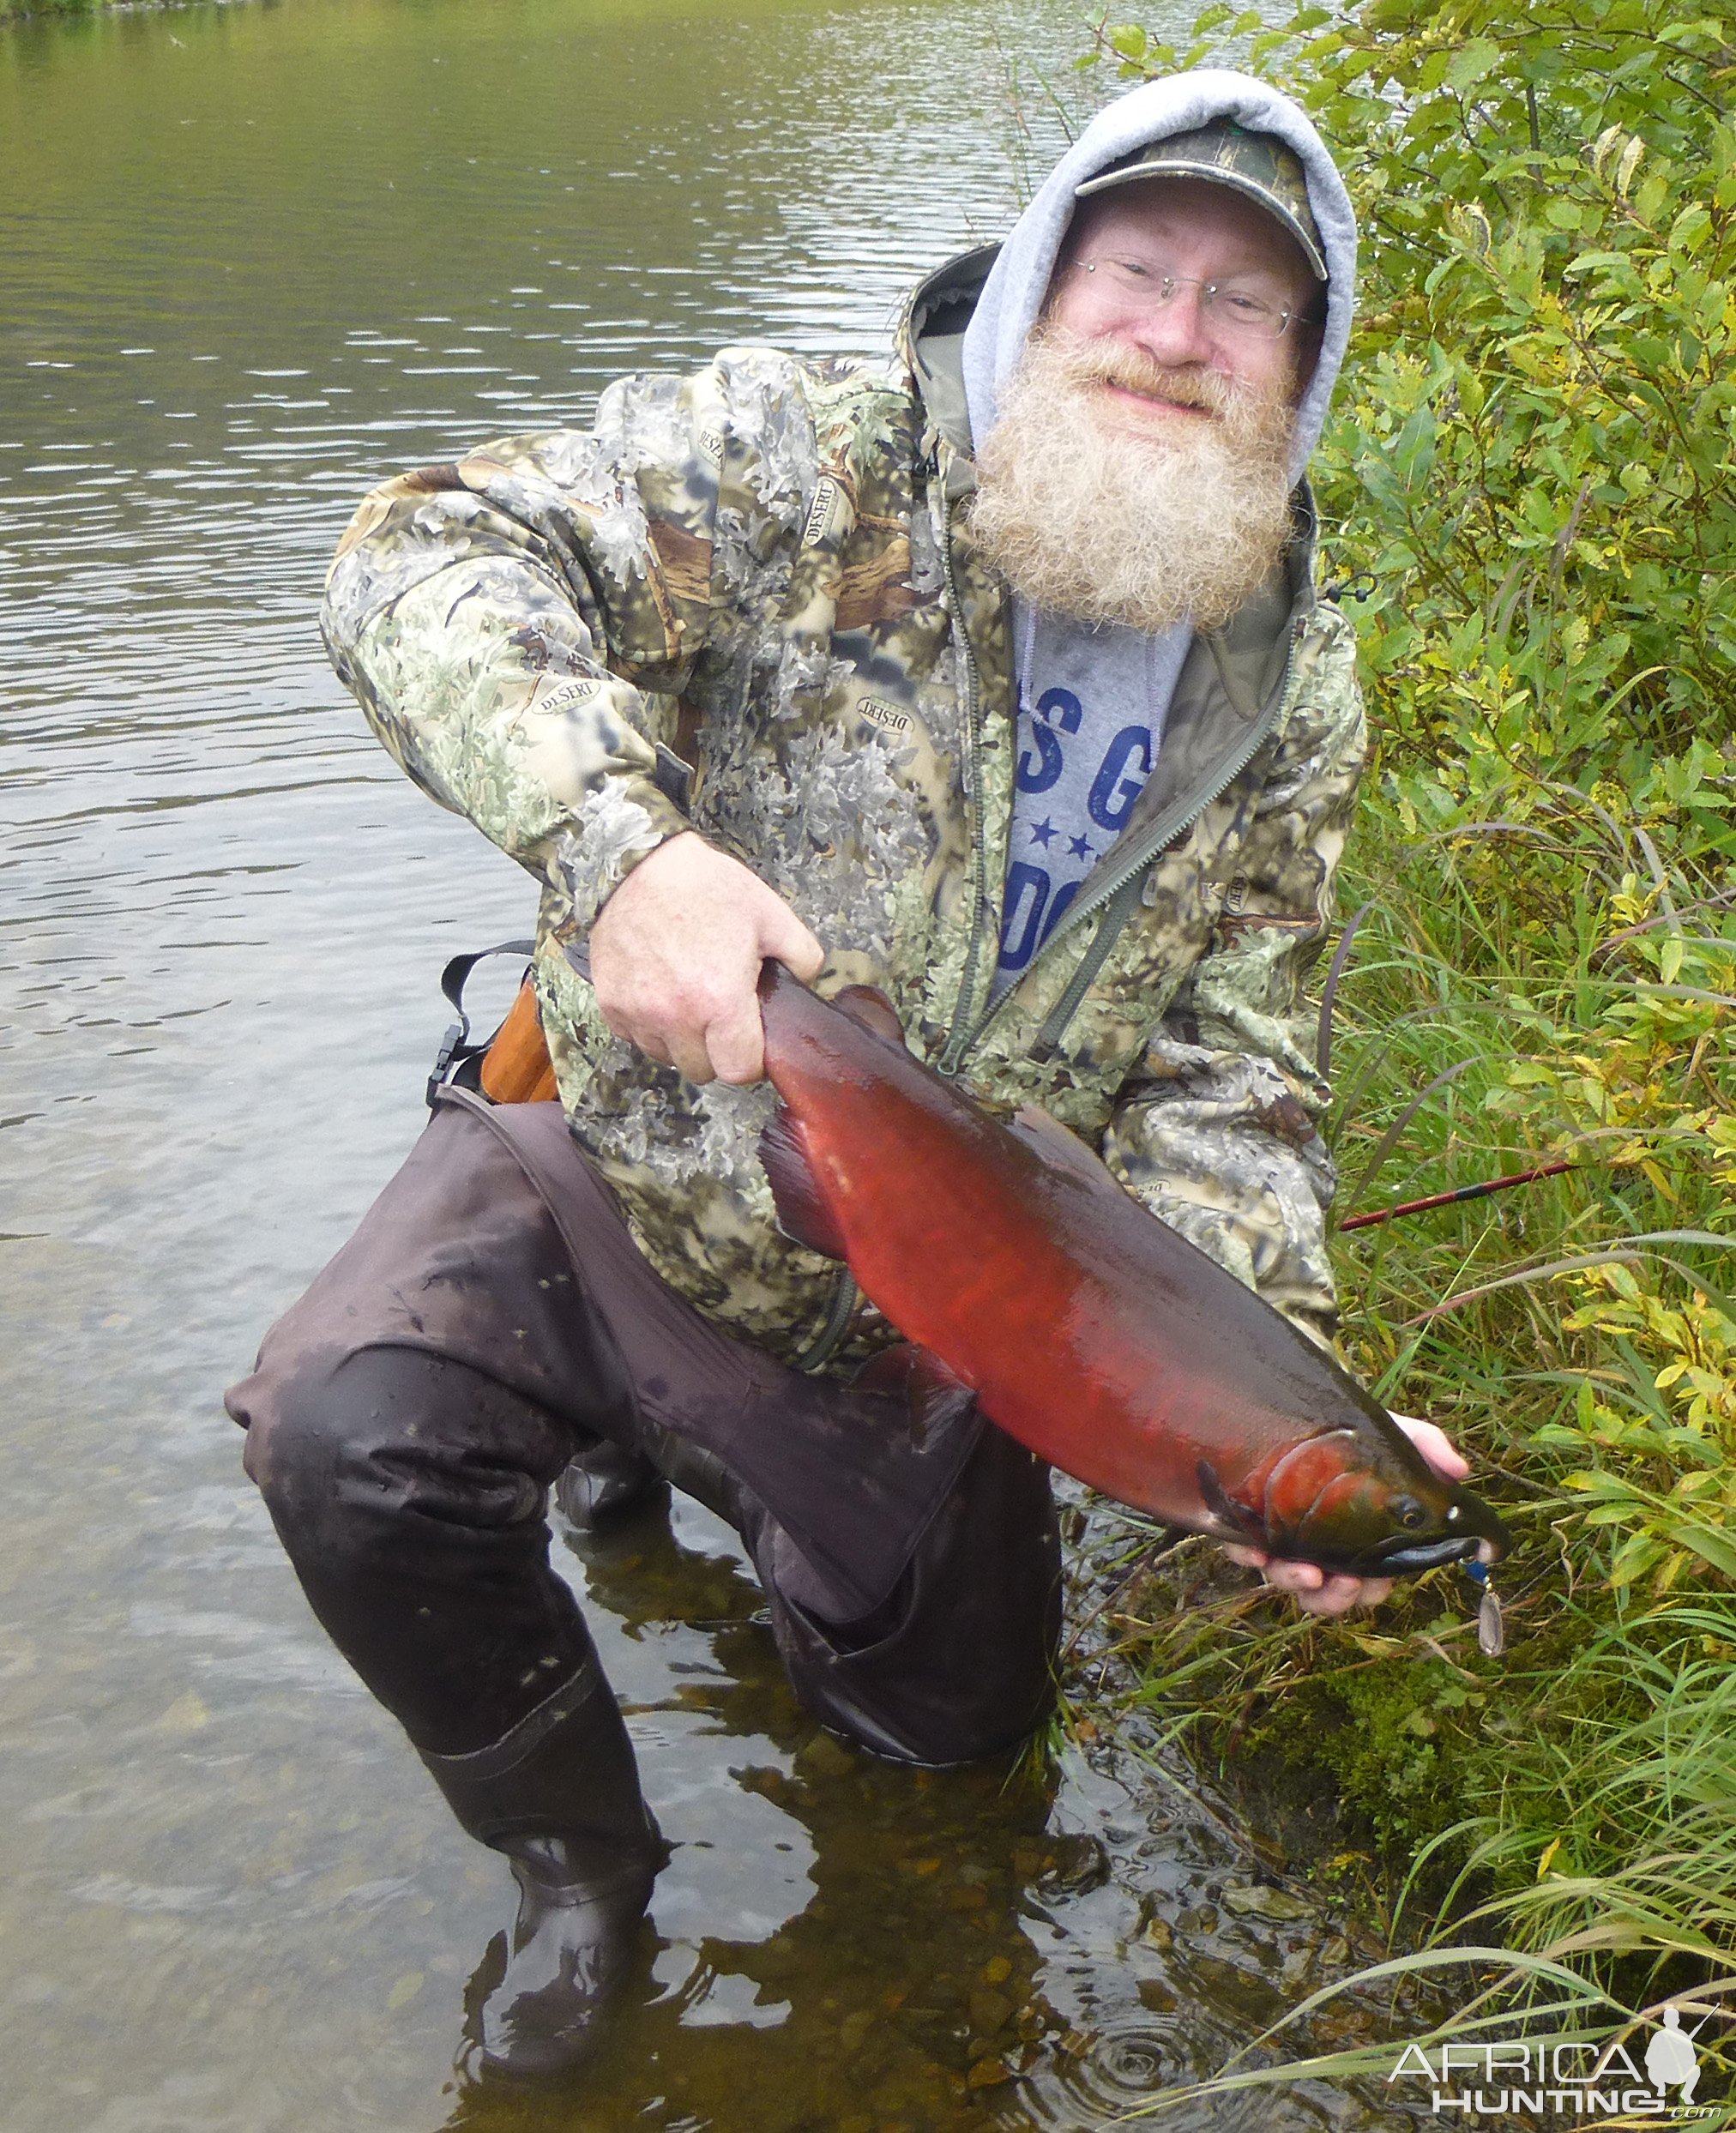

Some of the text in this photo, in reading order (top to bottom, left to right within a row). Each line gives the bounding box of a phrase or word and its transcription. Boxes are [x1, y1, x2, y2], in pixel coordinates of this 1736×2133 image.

[806, 480, 832, 538] DESERT
[540, 681, 594, 711] DESERT
[858, 701, 909, 731] DESERT
